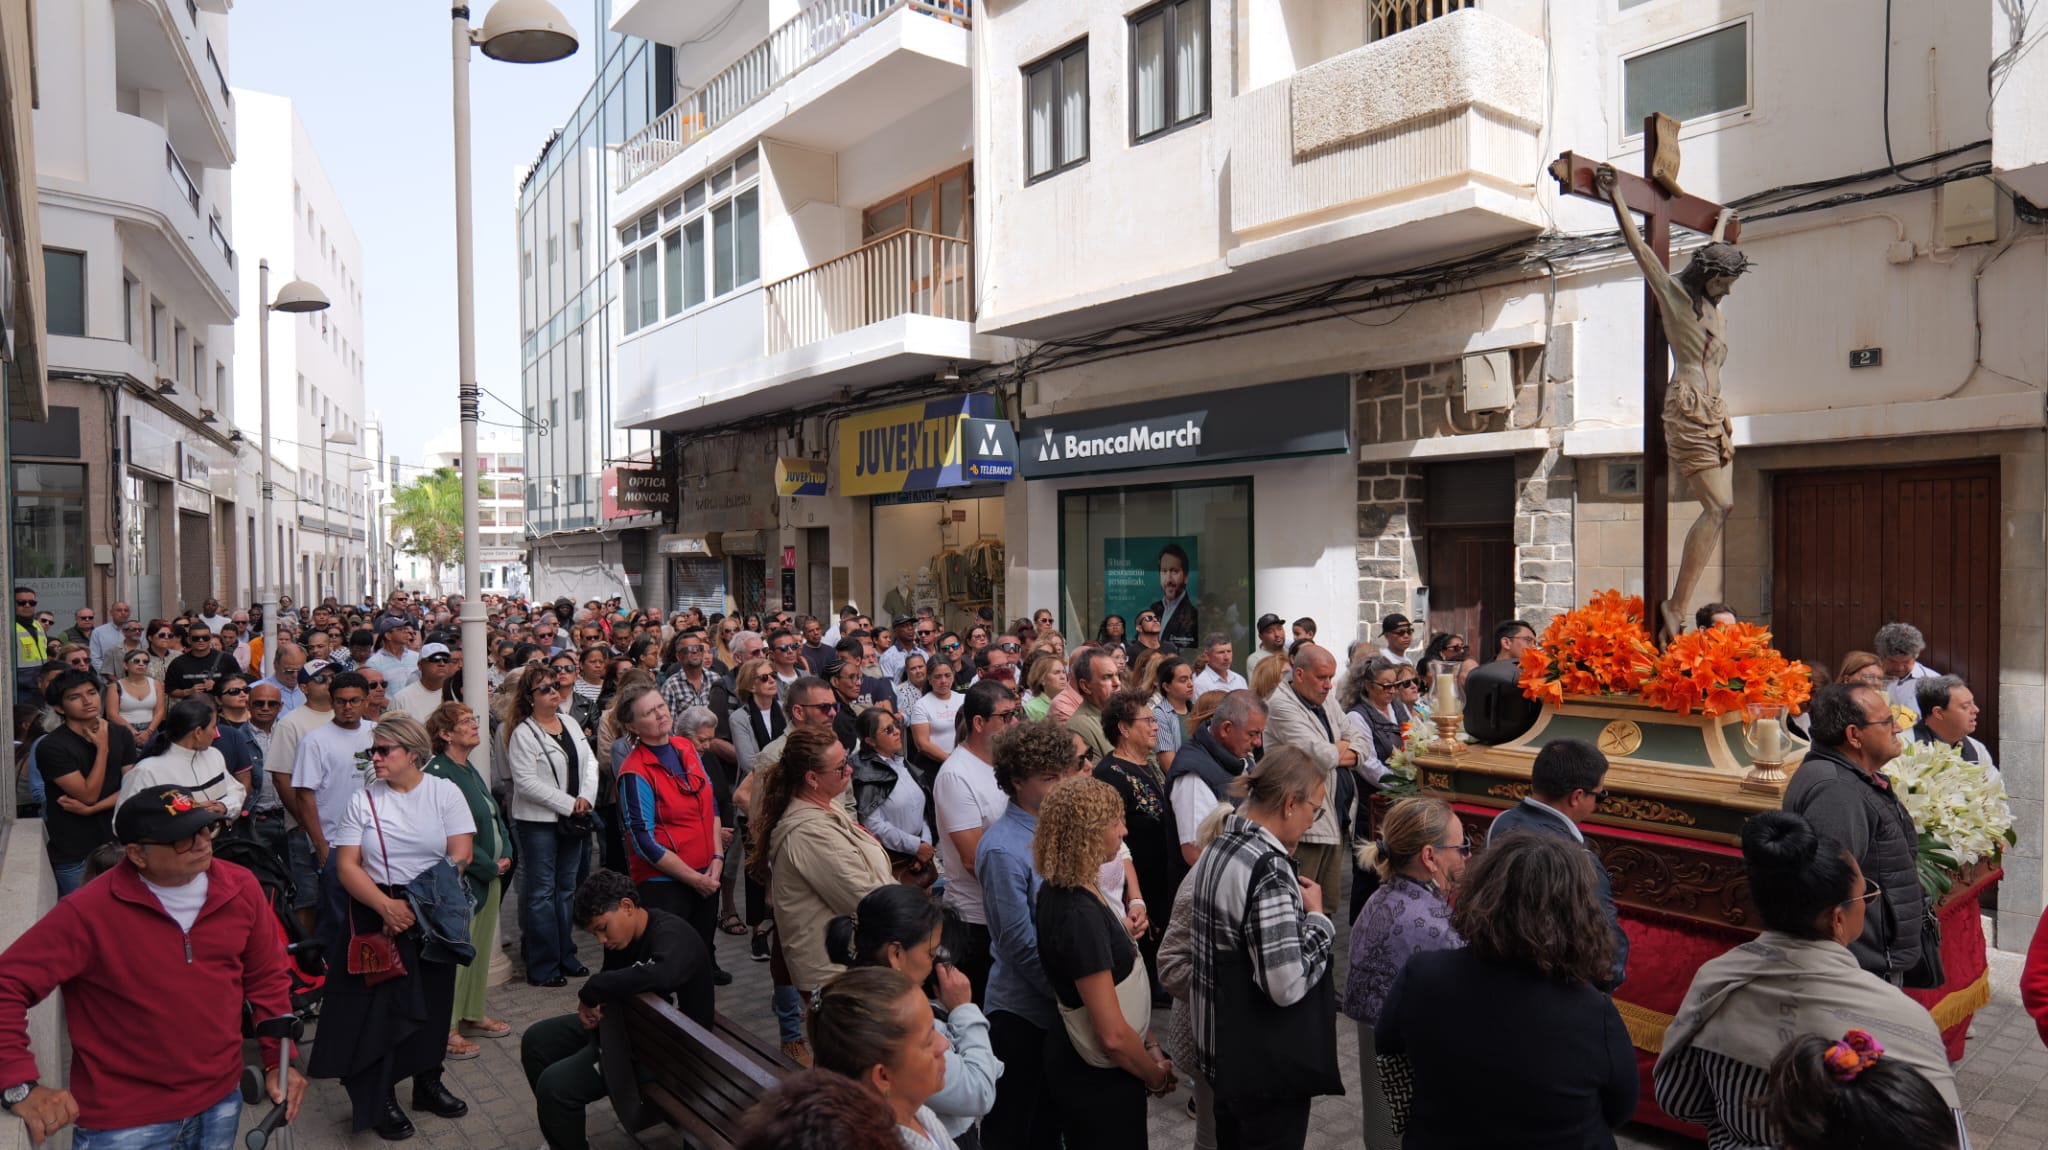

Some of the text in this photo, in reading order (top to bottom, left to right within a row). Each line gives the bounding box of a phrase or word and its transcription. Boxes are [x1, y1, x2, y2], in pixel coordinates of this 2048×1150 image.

[1859, 351, 1871, 364] 2
[1065, 420, 1201, 459] BancaMarch
[980, 465, 1013, 476] TELEBANCO
[628, 476, 667, 488] OPTICA
[785, 471, 826, 483] JUVENTUD
[624, 491, 670, 503] MONCAR
